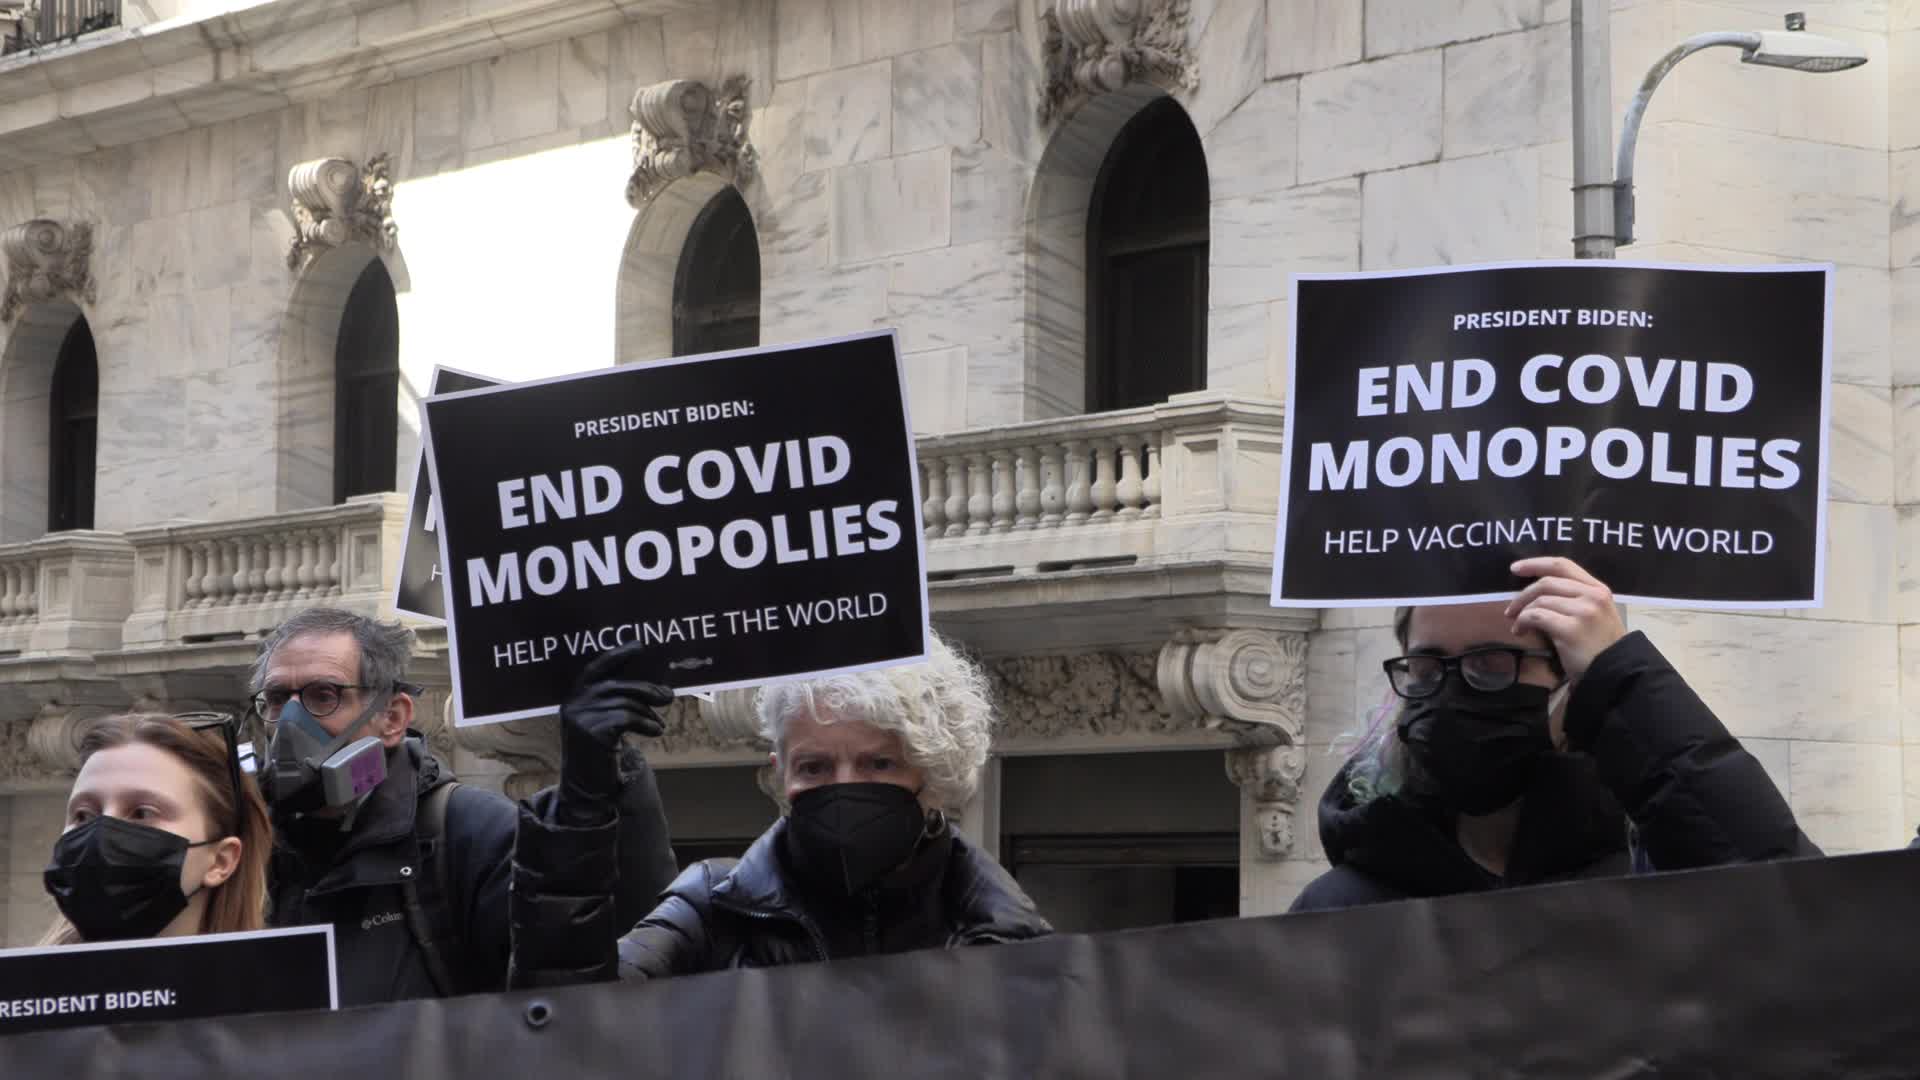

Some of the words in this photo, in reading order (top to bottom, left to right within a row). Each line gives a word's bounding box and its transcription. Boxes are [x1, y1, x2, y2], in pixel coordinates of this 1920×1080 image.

[1453, 308, 1572, 331] PRESIDENT
[1577, 308, 1654, 329] BIDEN:
[1356, 358, 1497, 417] END
[1519, 353, 1754, 413] COVID
[574, 407, 681, 439] PRESIDENT
[685, 399, 755, 423] BIDEN:
[497, 464, 623, 530] END
[643, 435, 851, 505] COVID
[1308, 425, 1801, 492] MONOPOLIES
[466, 499, 902, 607] MONOPOLIES
[1324, 528, 1400, 555] HELP
[1407, 516, 1574, 552] VACCINATE
[1581, 517, 1644, 549] THE
[1652, 524, 1774, 555] WORLD
[493, 636, 558, 668] HELP
[563, 614, 717, 656] VACCINATE
[723, 606, 780, 635] THE
[785, 592, 887, 627] WORLD
[0, 994, 100, 1018] RESIDENT
[104, 988, 176, 1010] BIDEN:
